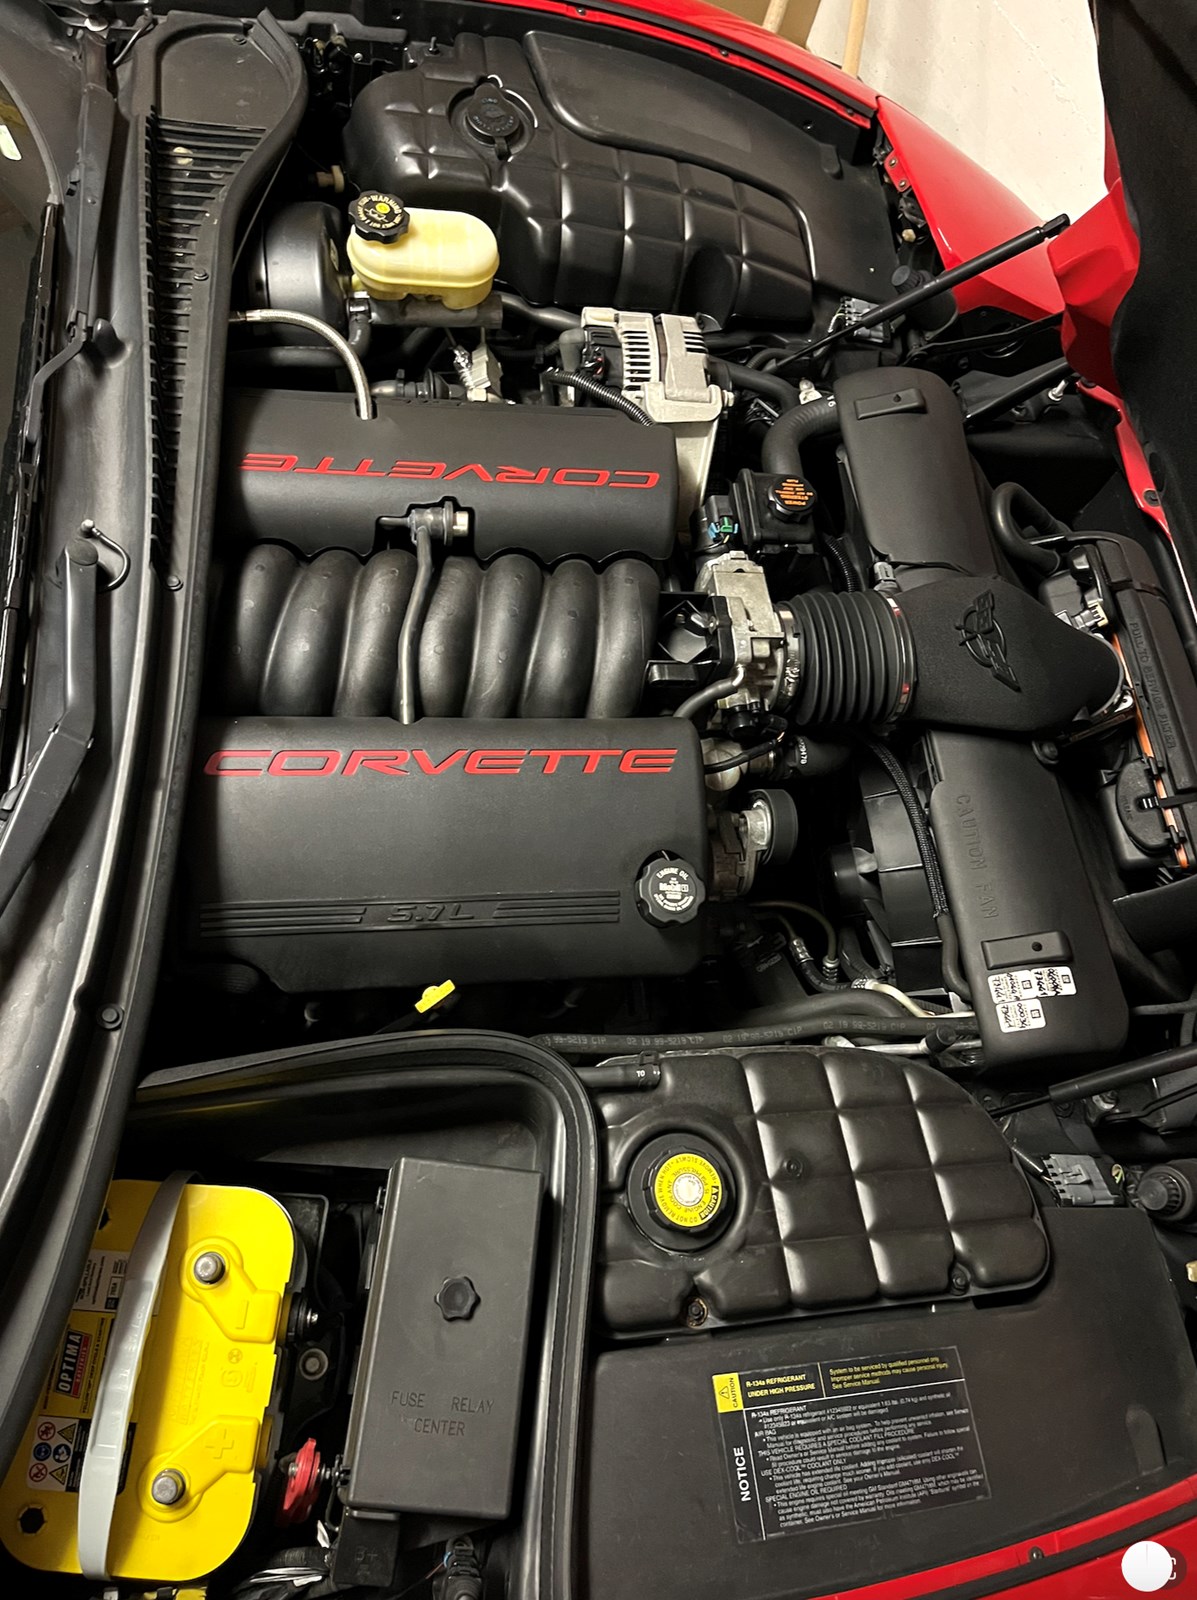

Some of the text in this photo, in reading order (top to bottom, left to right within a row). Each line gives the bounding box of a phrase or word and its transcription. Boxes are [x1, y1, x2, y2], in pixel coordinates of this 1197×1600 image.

[370, 195, 403, 214] WARNING
[240, 453, 660, 489] CORVETTE
[1128, 622, 1177, 750] PULL TO SERVICE FILTER
[204, 748, 677, 777] CORVETTE
[956, 794, 999, 919] CAUTION FAN
[655, 867, 678, 878] ENGINE
[678, 870, 689, 880] OIL
[387, 902, 475, 923] 5.7L
[626, 1036, 637, 1046] 02
[641, 1036, 650, 1045] 19
[654, 1036, 687, 1045] 99-5219
[636, 1069, 646, 1078] TO
[684, 1201, 706, 1213] ENGINE
[701, 1196, 717, 1218] CAUTION
[57, 1333, 82, 1392] OPTIMA
[75, 1346, 88, 1382] BATTERIES
[829, 1367, 848, 1376] System
[848, 1366, 854, 1374] to
[861, 1363, 882, 1372] serviced
[881, 1362, 888, 1370] by
[887, 1360, 908, 1369] qualified
[745, 1374, 807, 1388] R-134a REFRIGERANT
[830, 1374, 853, 1383] Improper
[852, 1372, 871, 1380] service
[870, 1369, 892, 1378] methods
[902, 1366, 917, 1374] cause
[730, 1377, 738, 1408] CAUTION
[747, 1383, 816, 1398] UNDER HIGH PRESSURE
[831, 1382, 843, 1390] See
[842, 1380, 862, 1389] Service
[391, 1391, 495, 1415] FUSE RELAY
[751, 1405, 807, 1418] R-134a REFRIGERANT
[414, 1416, 466, 1437] CENTER
[754, 1430, 764, 1438] AIR
[827, 1438, 849, 1447] SPECIAL
[848, 1434, 874, 1444] COOLANT
[884, 1428, 915, 1438] PROCEDURE
[733, 1446, 752, 1502] NOTICE
[761, 1469, 773, 1477] USE
[807, 1460, 833, 1470] COOLANT
[832, 1458, 847, 1466] ONLY
[765, 1493, 789, 1503] SPECIAL
[788, 1490, 811, 1499] ENGINE
[819, 1483, 848, 1494] REQUIRED
